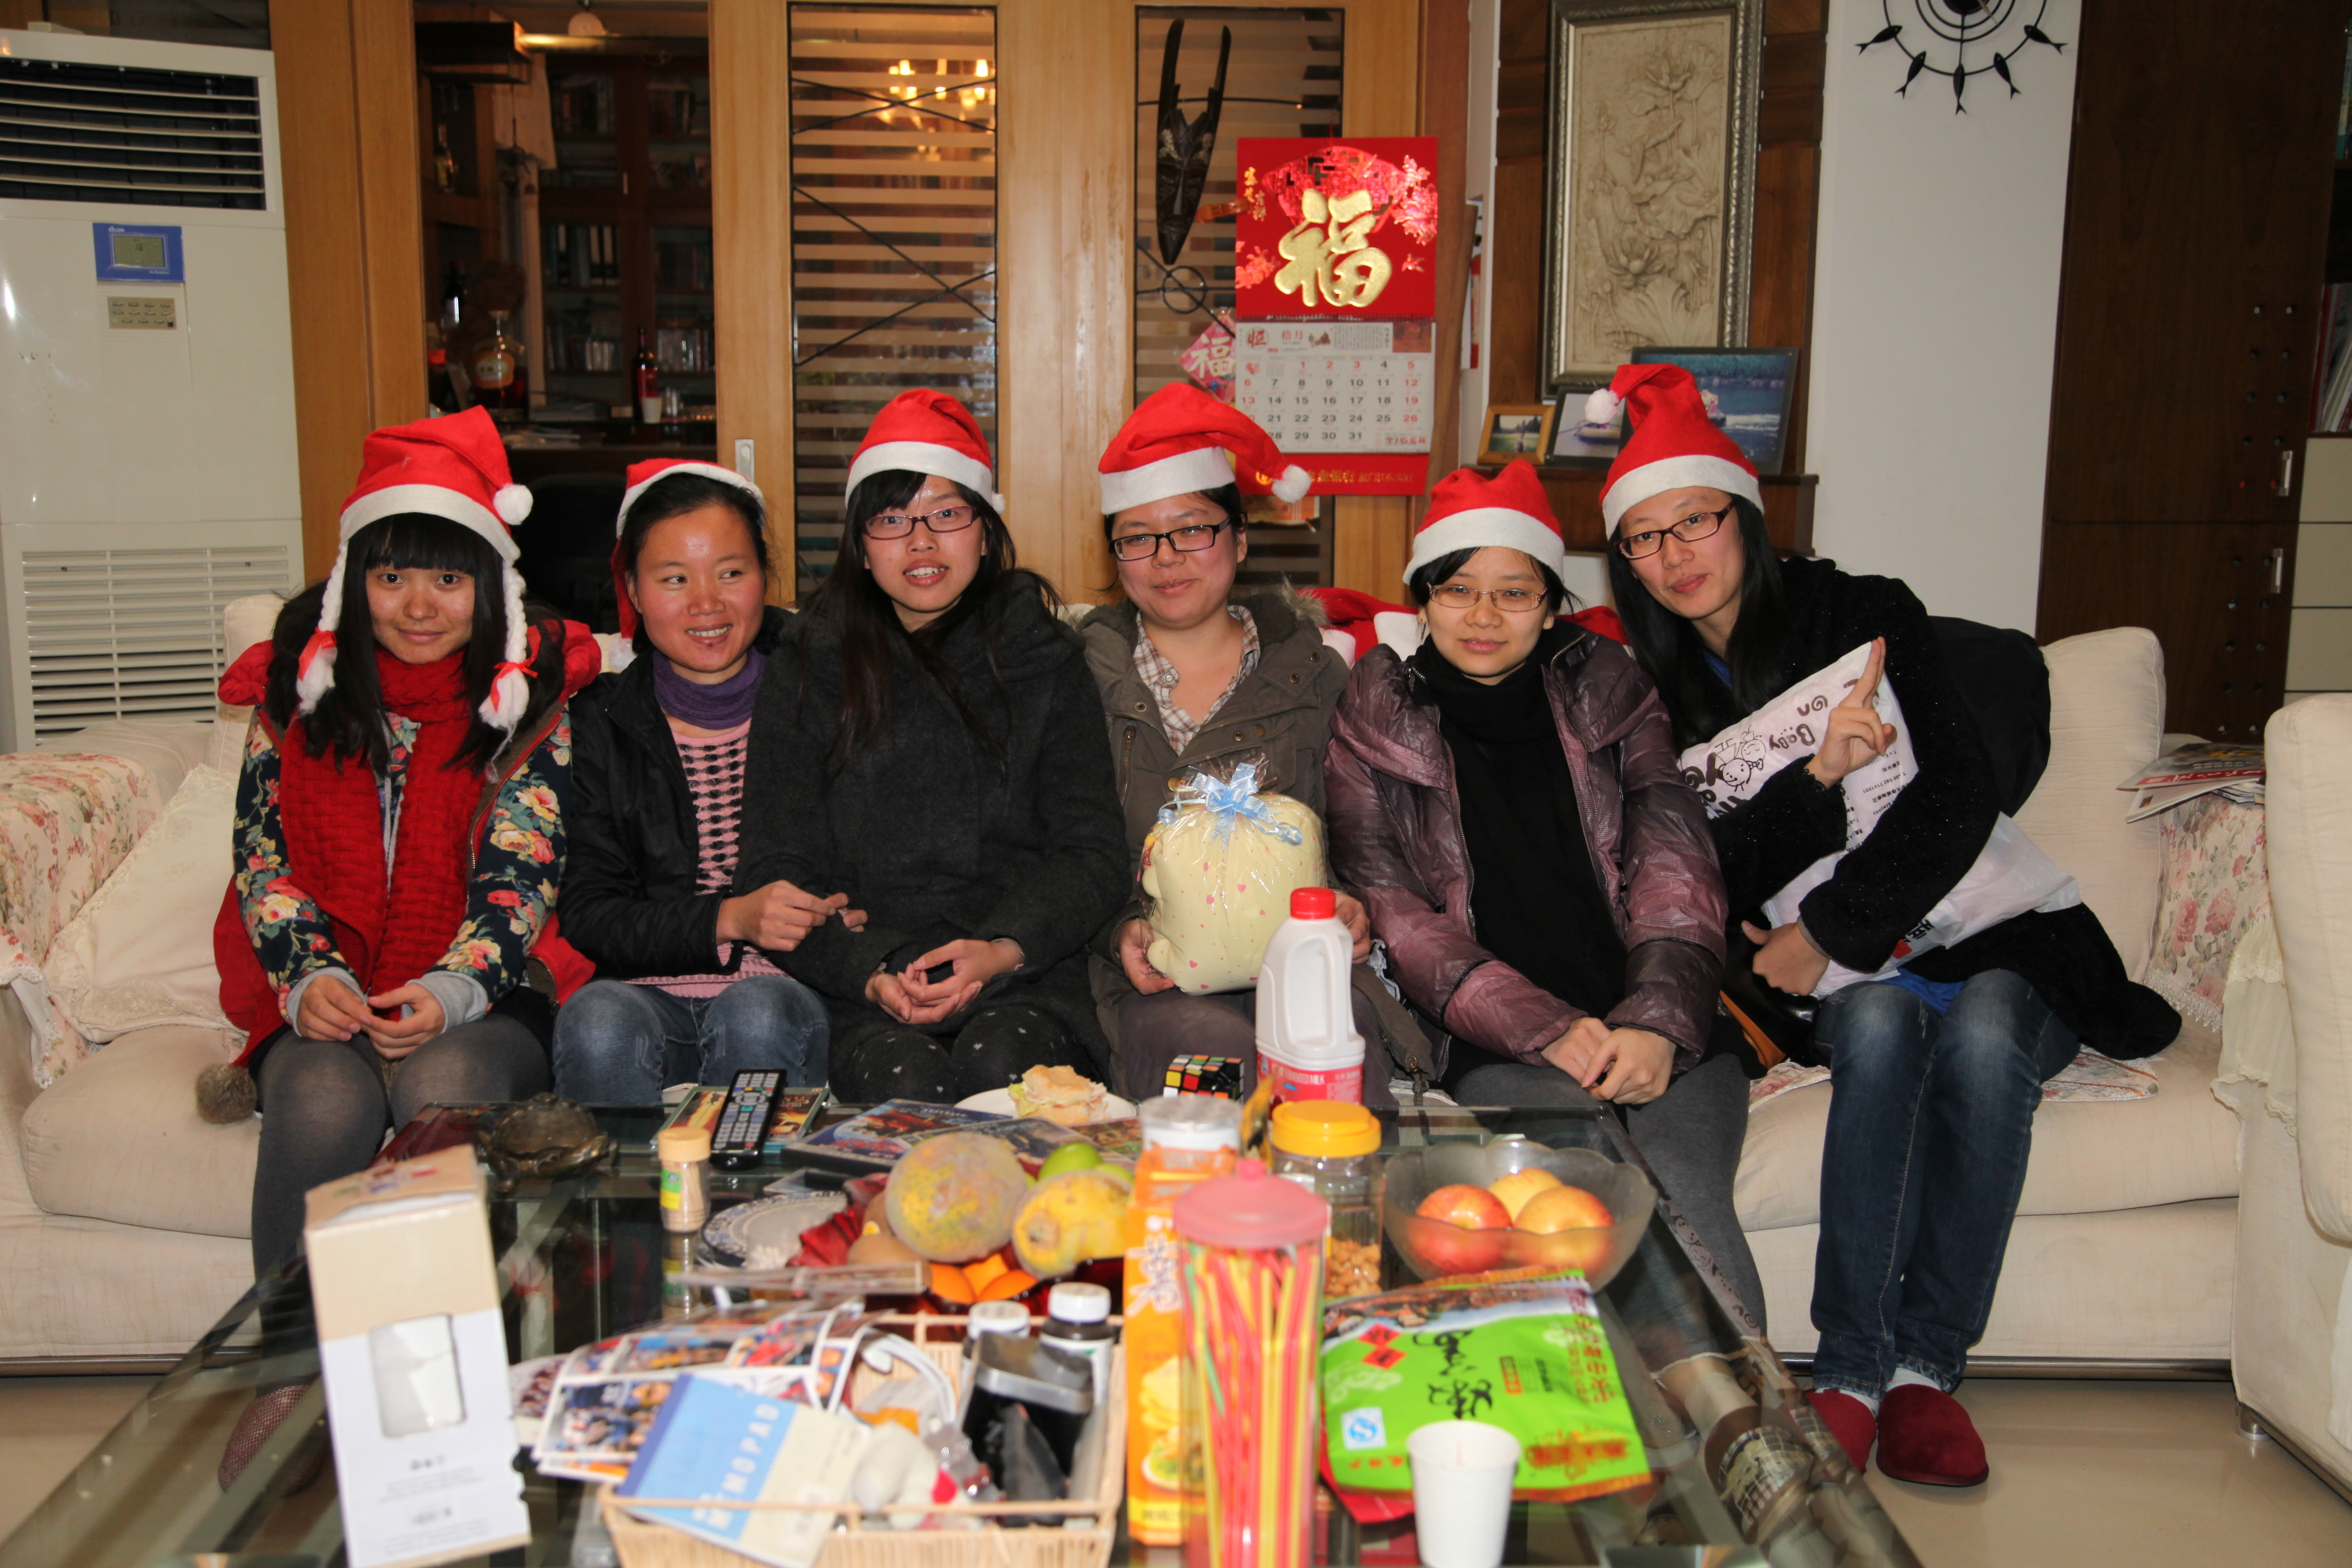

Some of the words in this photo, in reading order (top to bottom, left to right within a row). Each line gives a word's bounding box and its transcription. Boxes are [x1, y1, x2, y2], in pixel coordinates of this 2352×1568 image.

[1274, 188, 1392, 308] 福
[1188, 333, 1235, 378] 福
[1267, 414, 1281, 422] 21
[1294, 414, 1309, 422] 22
[1321, 414, 1336, 422] 23
[1349, 414, 1363, 422] 24
[1376, 414, 1391, 422] 25
[1403, 414, 1418, 422] 26
[1310, 1074, 1326, 1085] MILK
